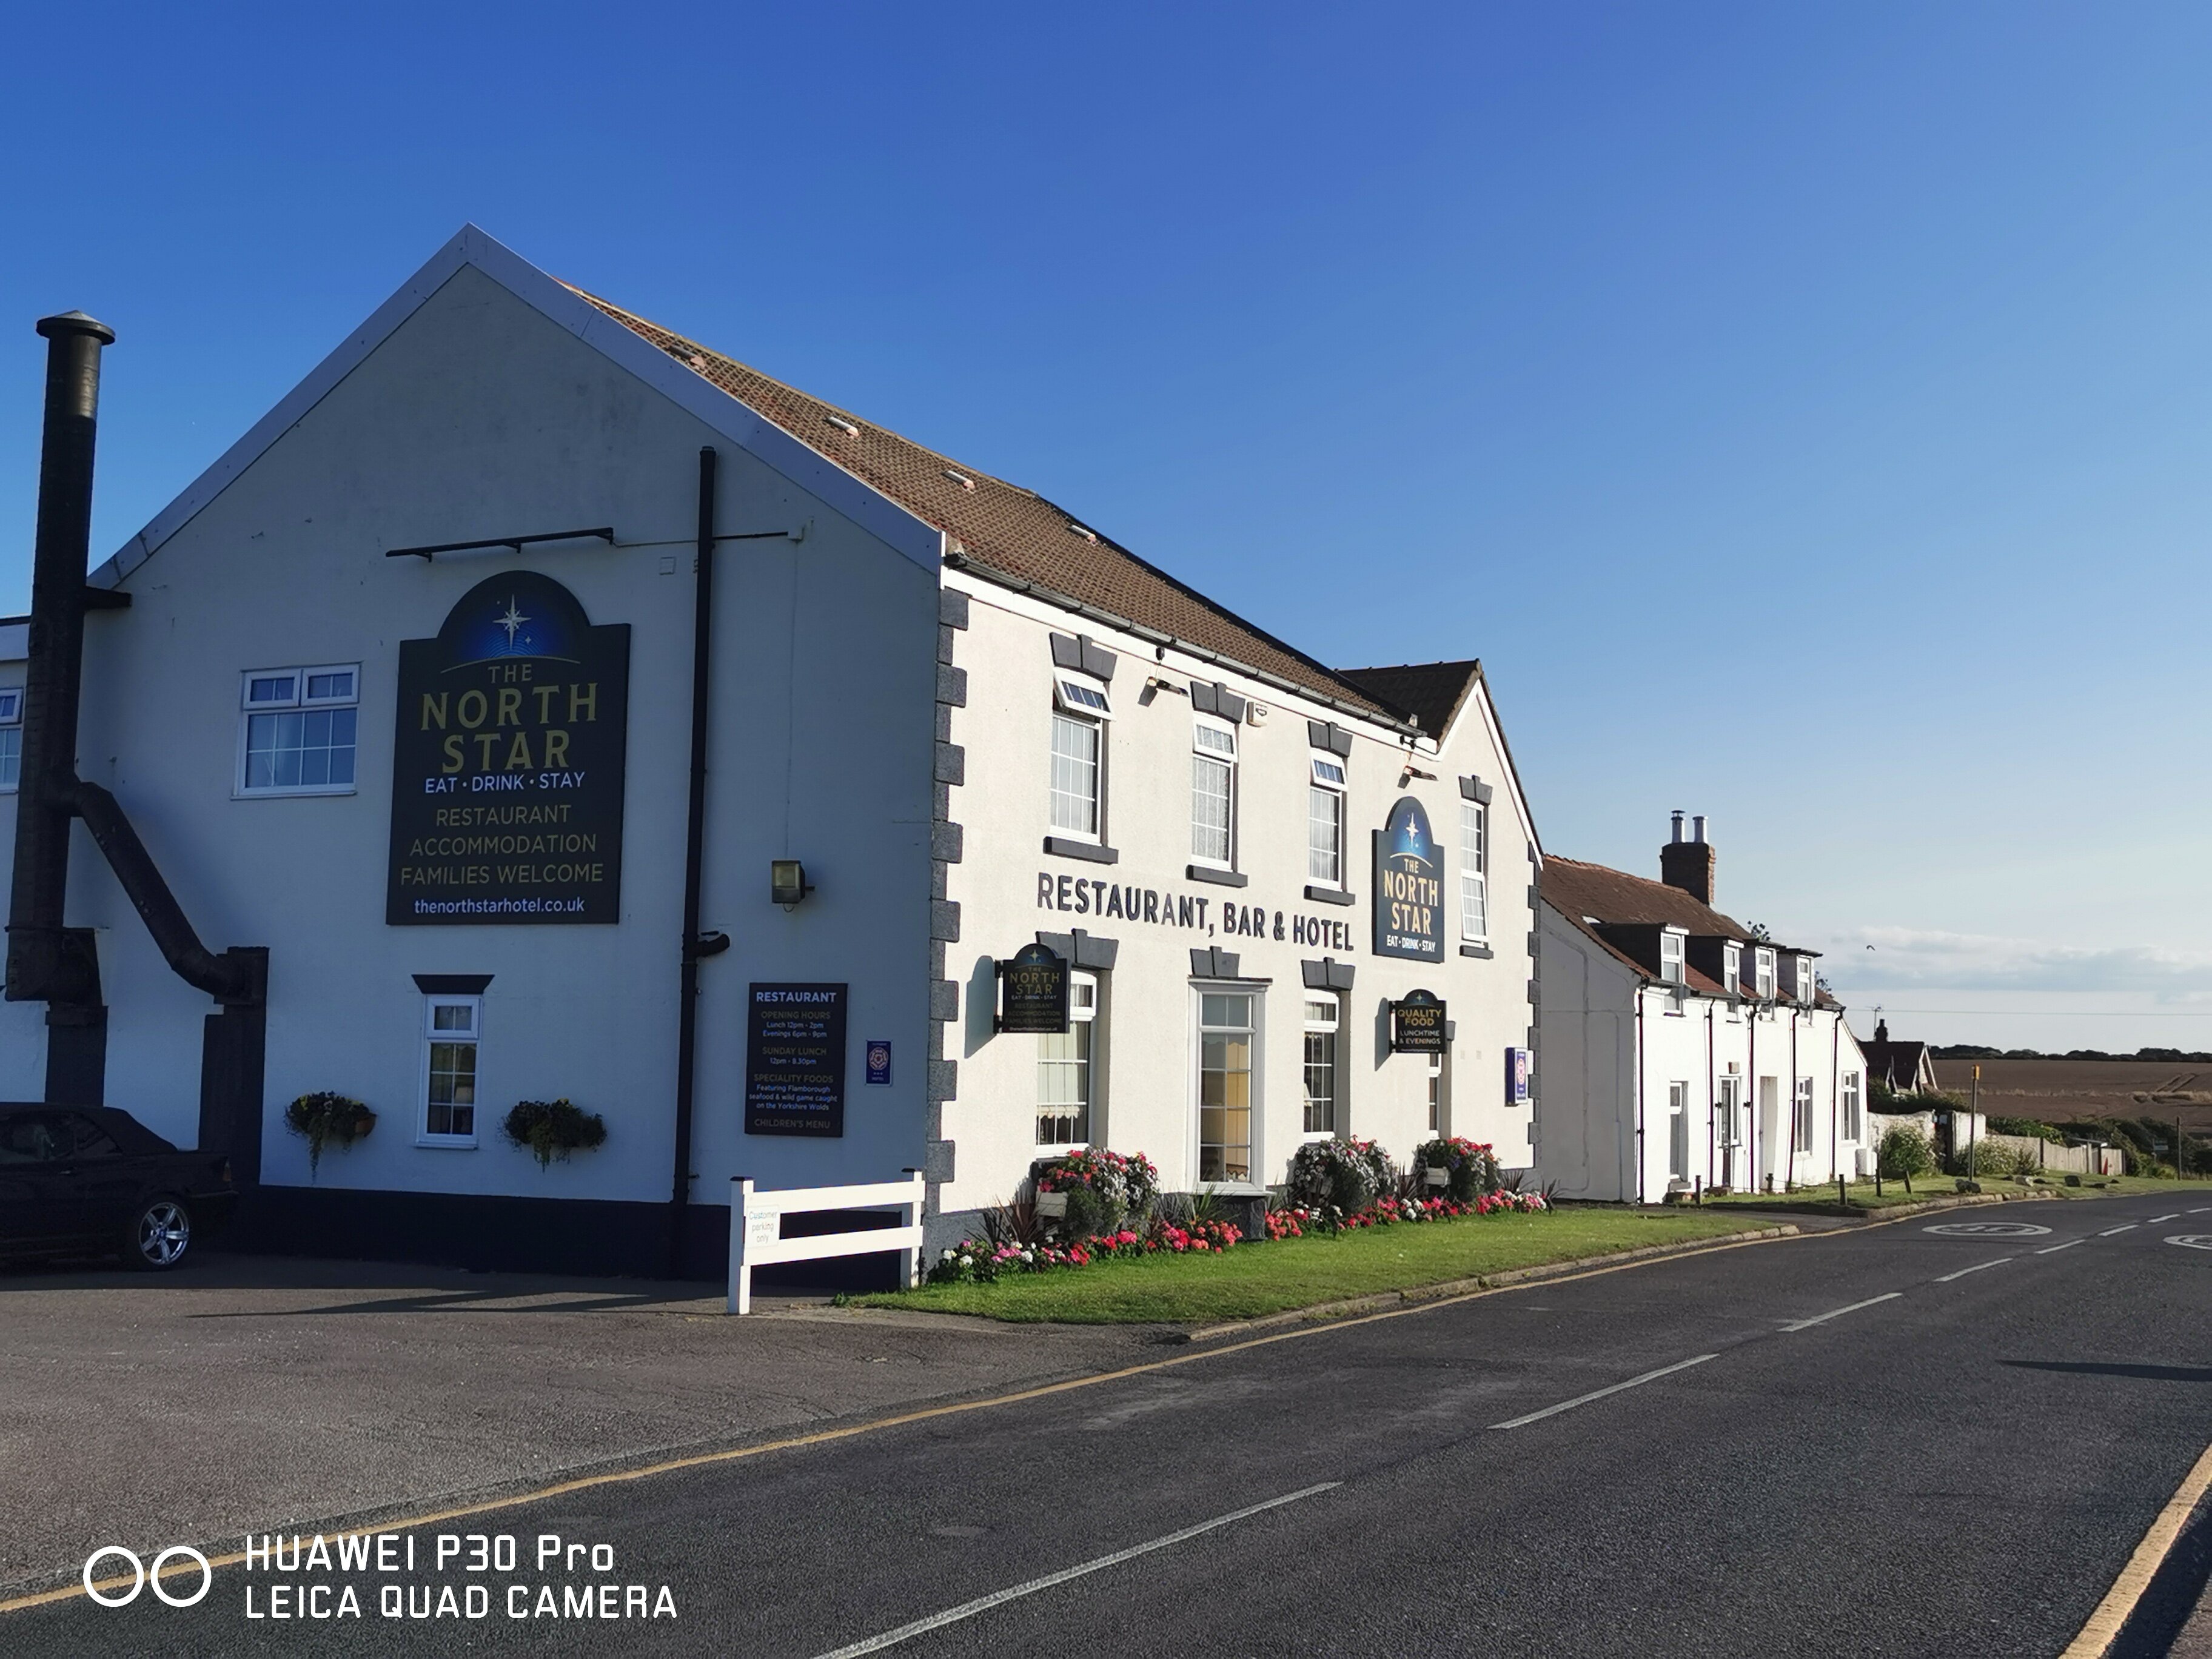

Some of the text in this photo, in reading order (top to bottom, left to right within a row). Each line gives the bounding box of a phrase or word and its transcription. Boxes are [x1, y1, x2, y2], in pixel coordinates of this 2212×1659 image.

[488, 664, 532, 683] THE
[421, 682, 598, 730] NORTH
[442, 730, 569, 773] STAR
[425, 772, 585, 793] EAT DRINK STAY
[436, 805, 571, 826] RESTAURANT
[409, 833, 597, 856] ACCOMMODATION
[1404, 858, 1419, 874] THE
[401, 863, 604, 885] FAMILIES WELCOME
[1384, 869, 1439, 908] NORTH
[415, 897, 585, 913] thenorthstarhotel.co.uk
[1037, 872, 1354, 951] RESTAURANT, BAR & HOTEL
[1391, 902, 1432, 936] STAR
[1387, 934, 1436, 953] EAT DRINK STAY
[1009, 973, 1060, 984] NORTH
[1016, 984, 1053, 994] STAR
[756, 991, 837, 1002] RESTAURANT
[761, 1010, 831, 1019] OPENING HOURS
[1397, 1009, 1442, 1018] QUALITY
[1404, 1017, 1435, 1026] FOOD
[762, 1030, 791, 1038] Evenings
[762, 1046, 827, 1056] SUNDAY LUNCH
[754, 1073, 834, 1083] SPECIALITY FOODS
[754, 1118, 831, 1129] CHILDREN'S MENU
[749, 1211, 777, 1220] Customer
[751, 1222, 774, 1233] parking
[756, 1233, 769, 1244] only
